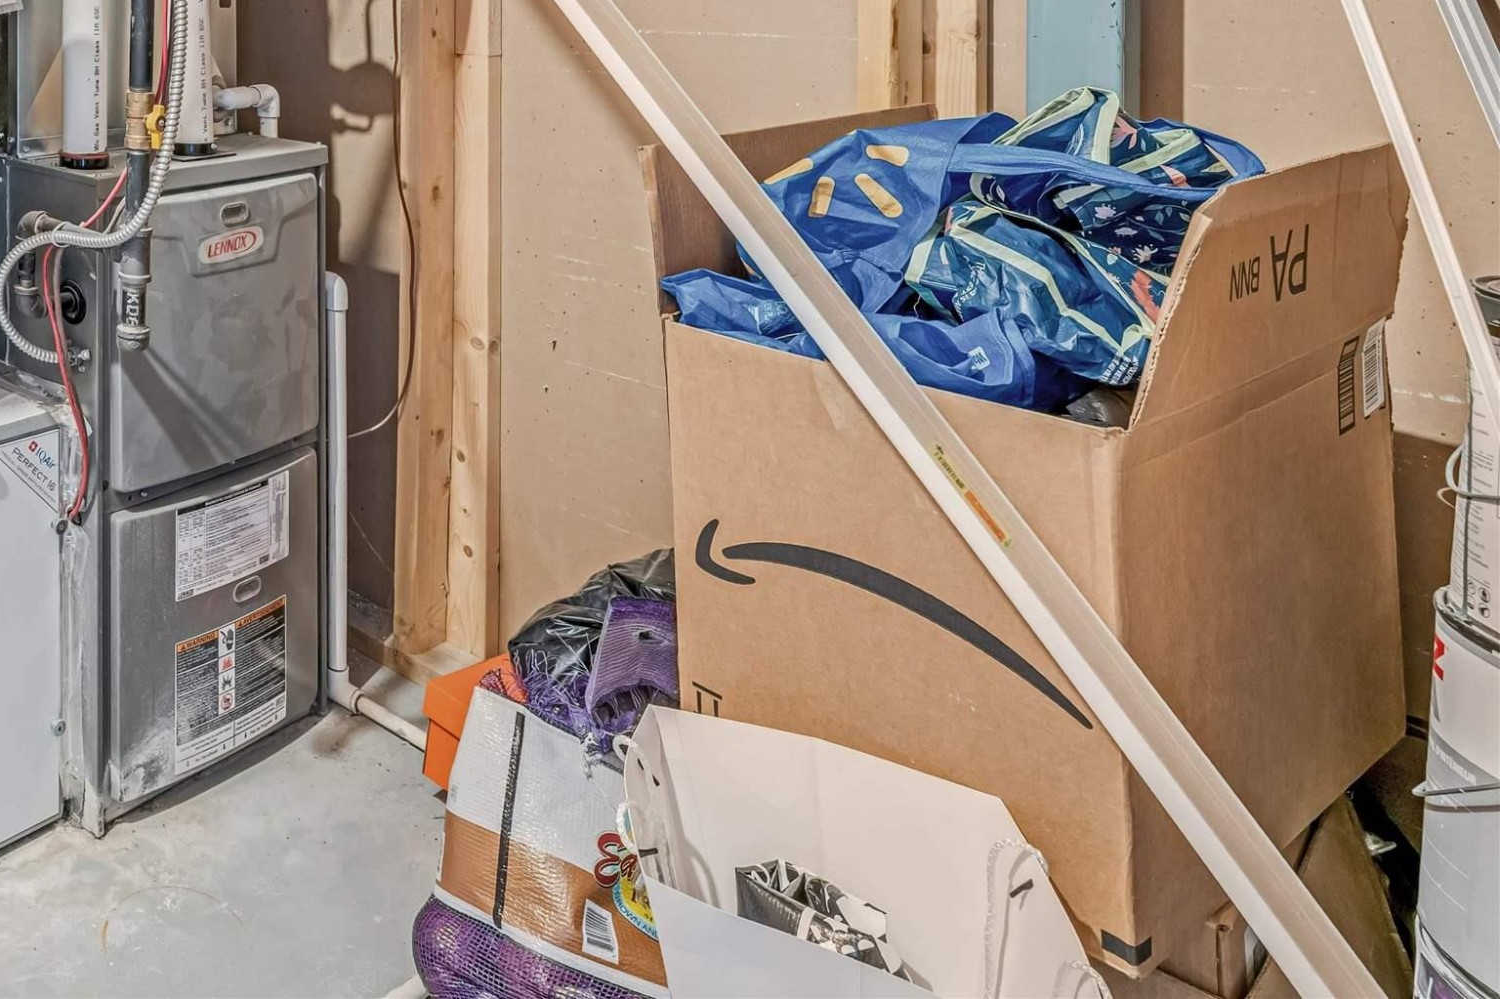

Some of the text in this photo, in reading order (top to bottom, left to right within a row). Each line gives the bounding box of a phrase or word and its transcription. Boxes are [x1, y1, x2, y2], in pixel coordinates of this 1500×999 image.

[208, 234, 248, 258] LENNOX
[1229, 224, 1309, 302] PA BNN
[12, 447, 48, 483] PERFECT
[47, 480, 56, 491] 16
[36, 447, 55, 469] IQAir
